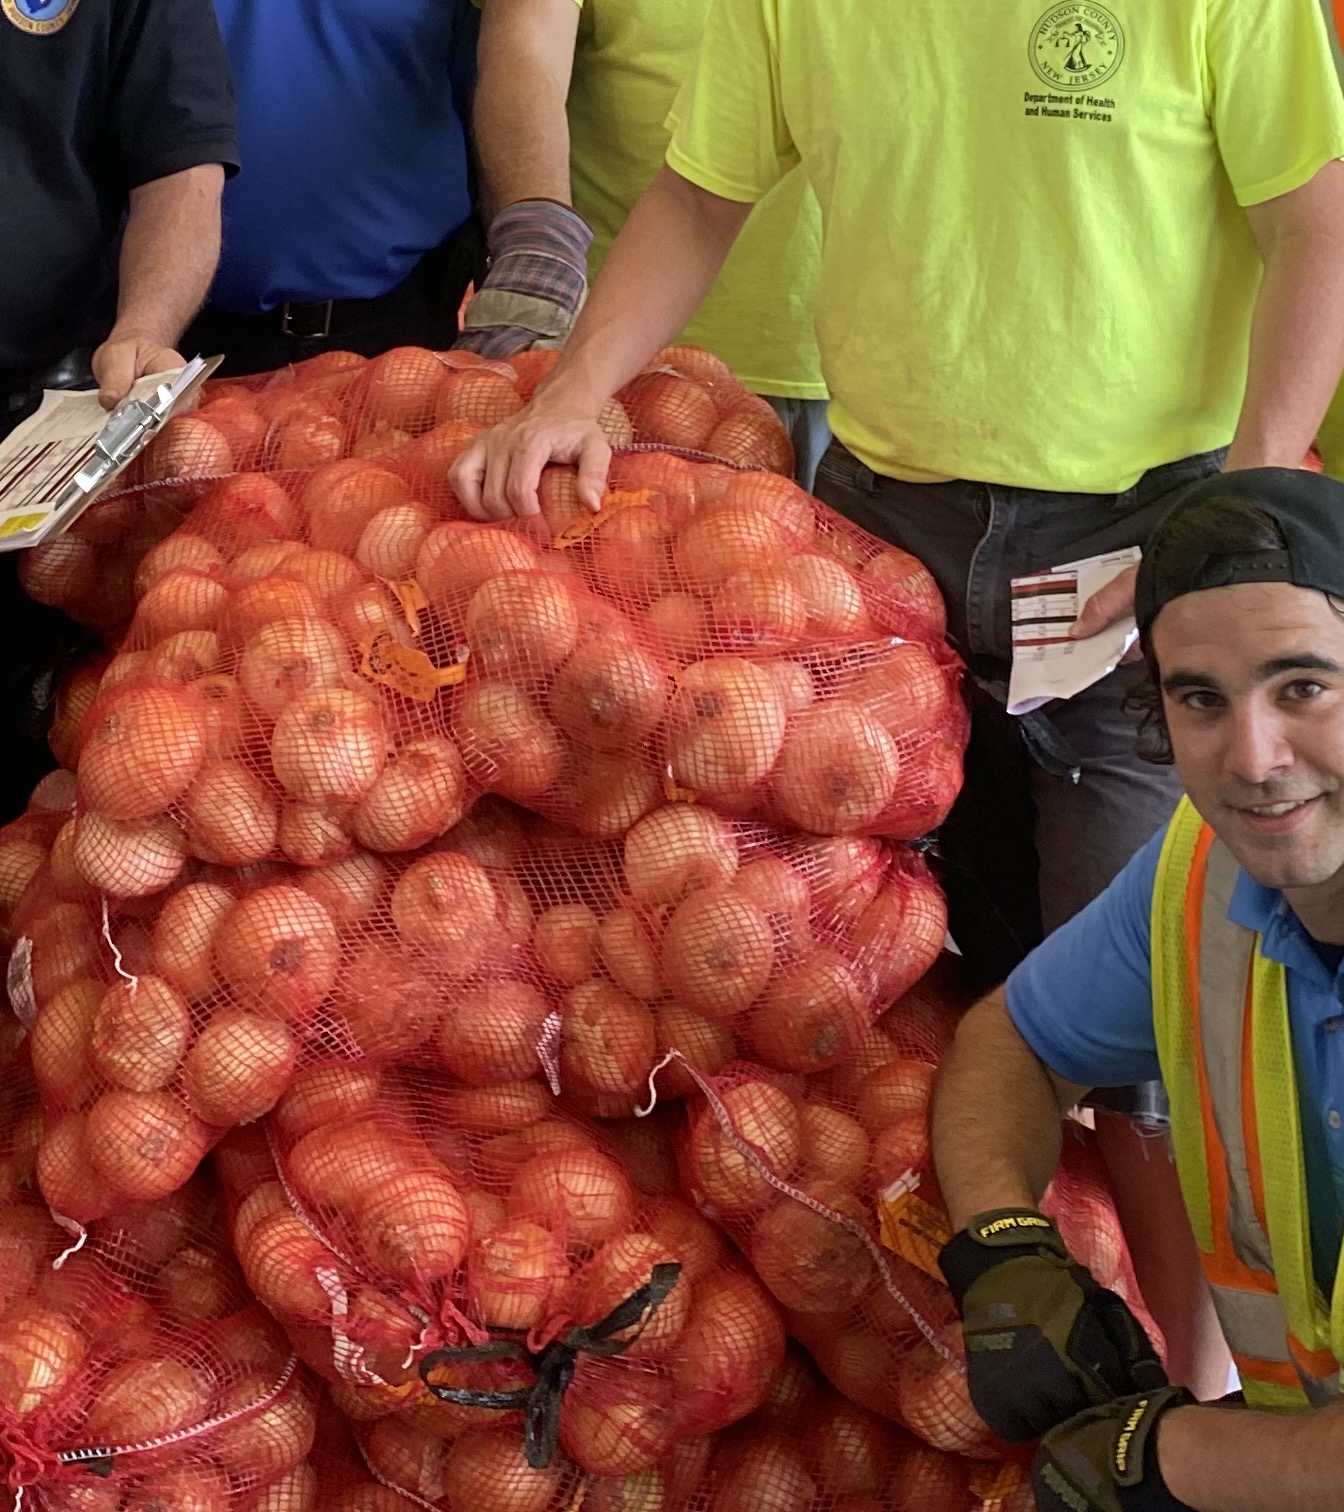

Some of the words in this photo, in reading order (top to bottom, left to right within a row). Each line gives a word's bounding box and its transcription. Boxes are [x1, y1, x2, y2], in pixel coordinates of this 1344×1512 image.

[1038, 6, 1080, 36] HUDSON
[1083, 7, 1117, 41] COUNTY
[1041, 60, 1063, 81] NEW
[1068, 62, 1108, 85] JERSEY
[1024, 92, 1073, 104] Department
[1075, 95, 1085, 105] of
[1086, 95, 1116, 109] Health
[1025, 106, 1039, 116] and
[1041, 106, 1071, 118] Human
[1073, 108, 1112, 122] Services
[980, 1218, 1017, 1237] FIRM
